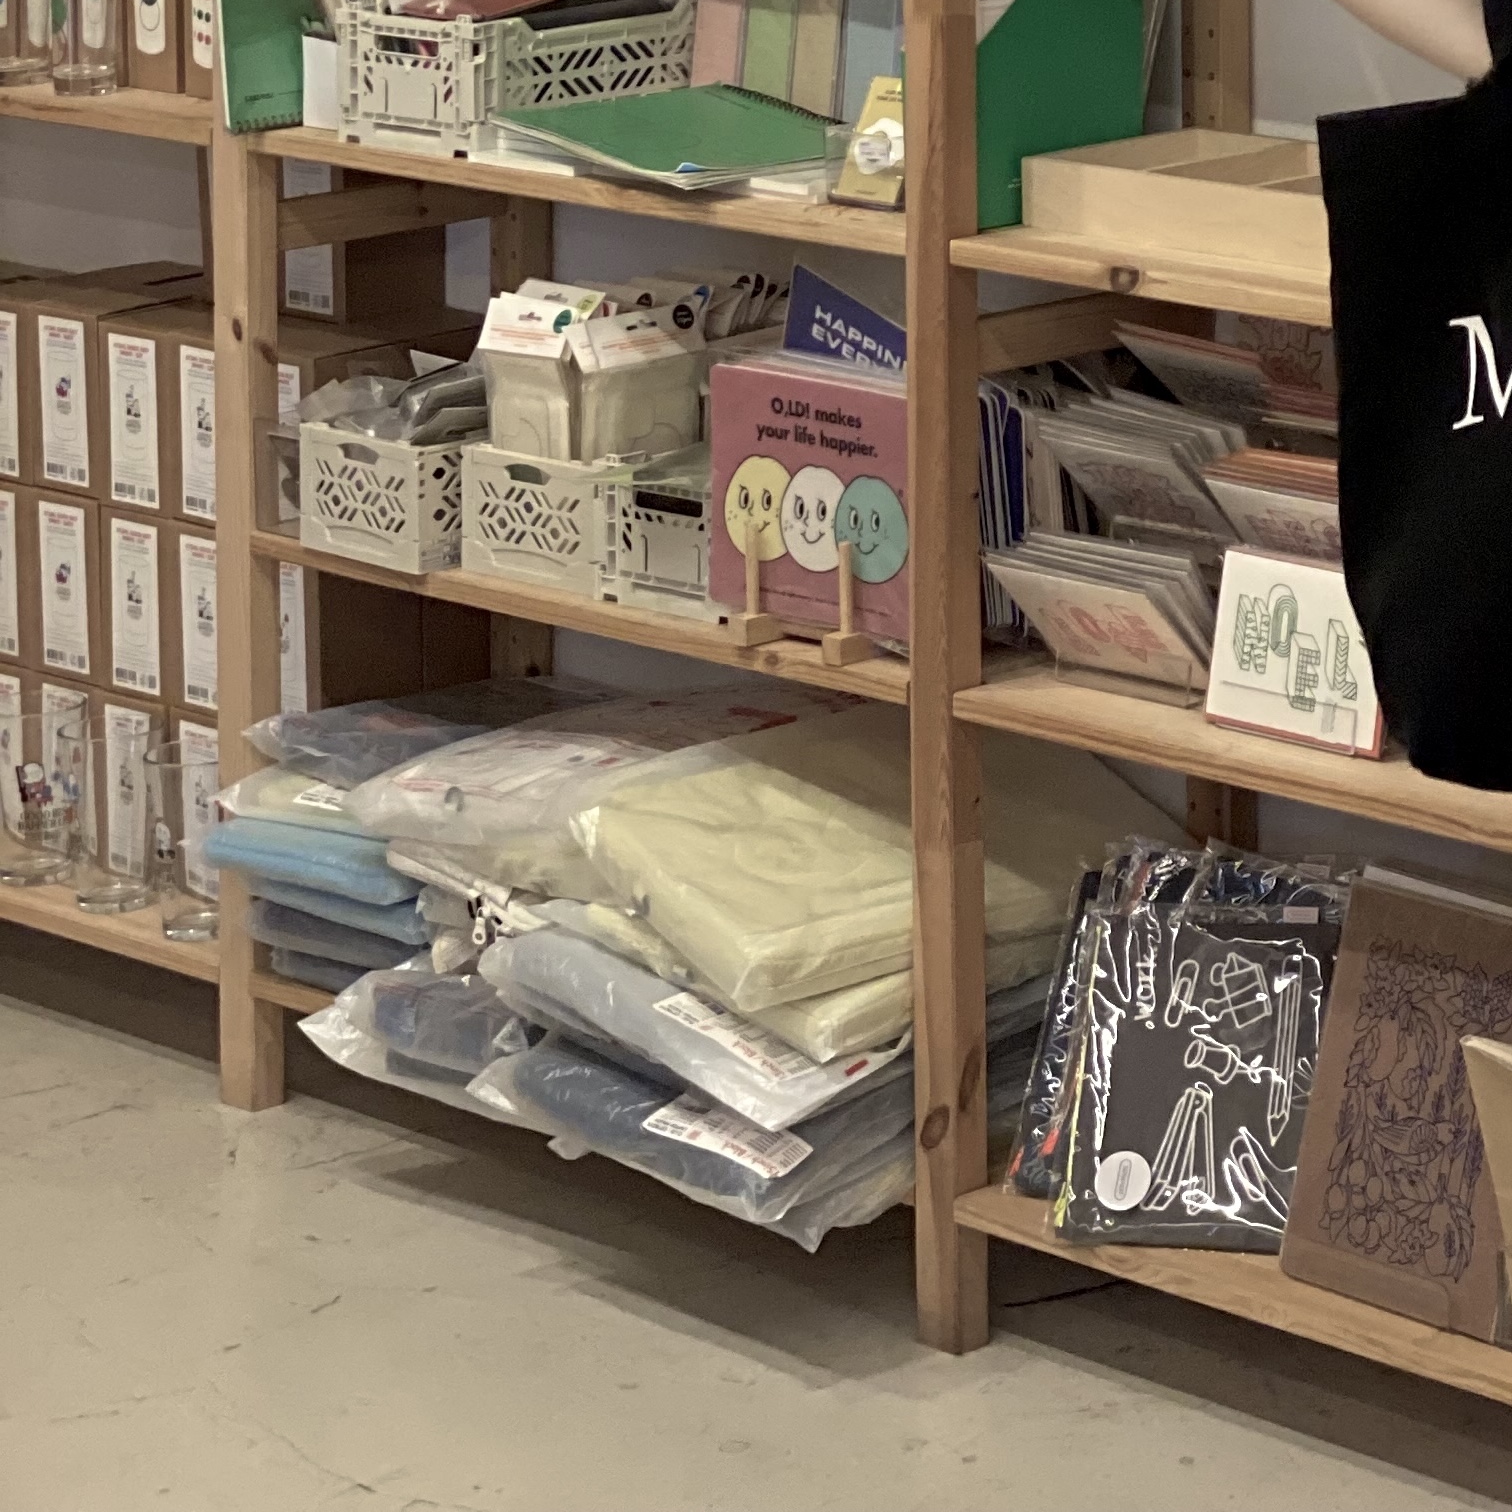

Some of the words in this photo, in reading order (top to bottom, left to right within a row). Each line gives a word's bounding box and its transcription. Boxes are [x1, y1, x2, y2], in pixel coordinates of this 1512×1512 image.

[770, 397, 810, 419] O,LD!
[814, 407, 862, 429] makes
[756, 423, 791, 442] your
[794, 424, 816, 446] life
[819, 429, 879, 458] happier.
